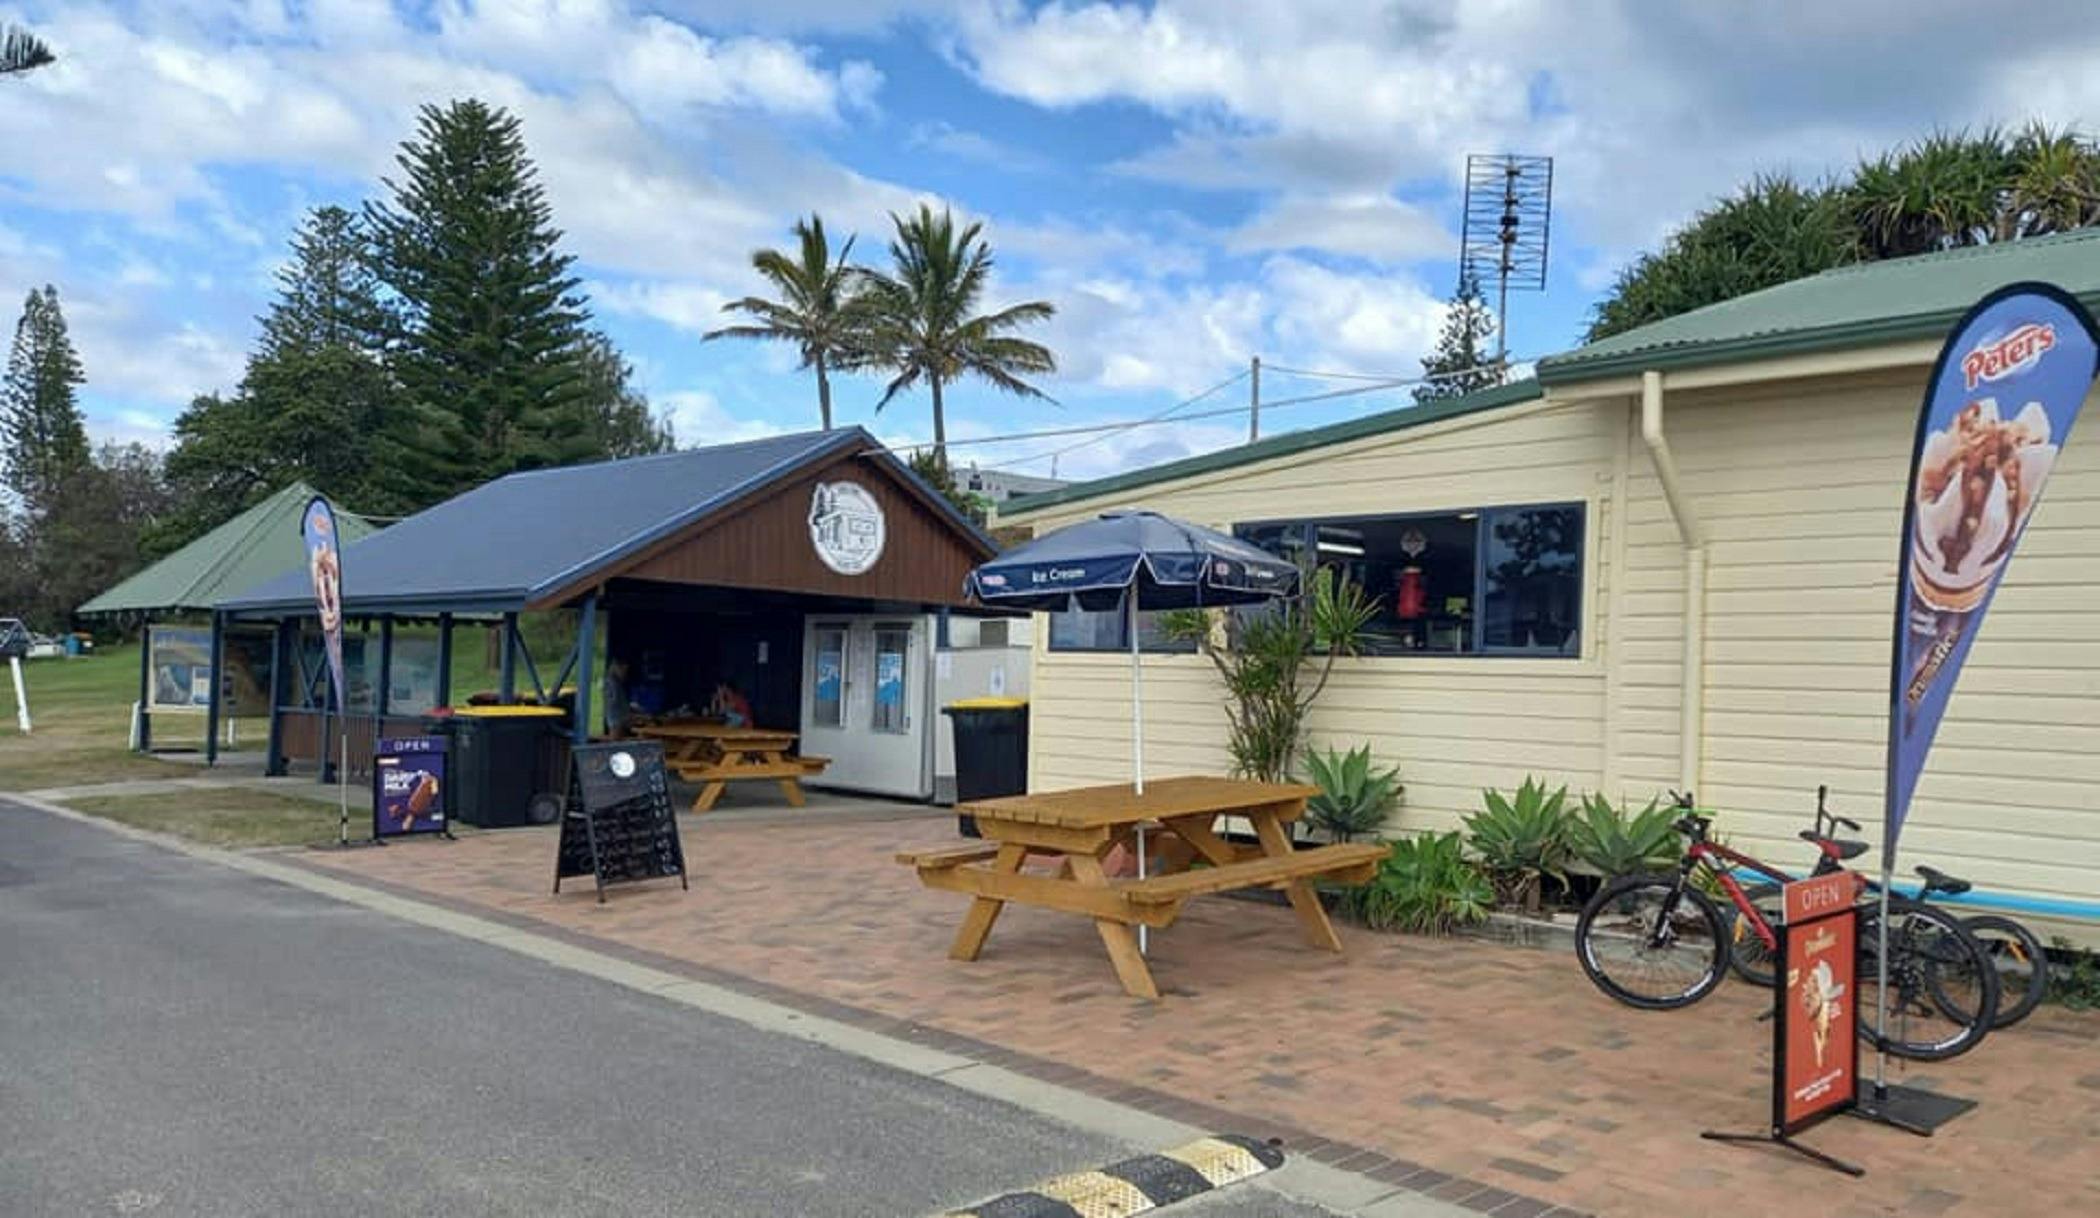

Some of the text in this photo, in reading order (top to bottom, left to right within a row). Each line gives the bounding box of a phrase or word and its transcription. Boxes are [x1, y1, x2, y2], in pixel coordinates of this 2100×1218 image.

[1963, 324, 2054, 389] Peters
[1032, 567, 1085, 583] Ice Cream
[394, 740, 430, 751] OPEN
[1802, 881, 1839, 911] OPEN
